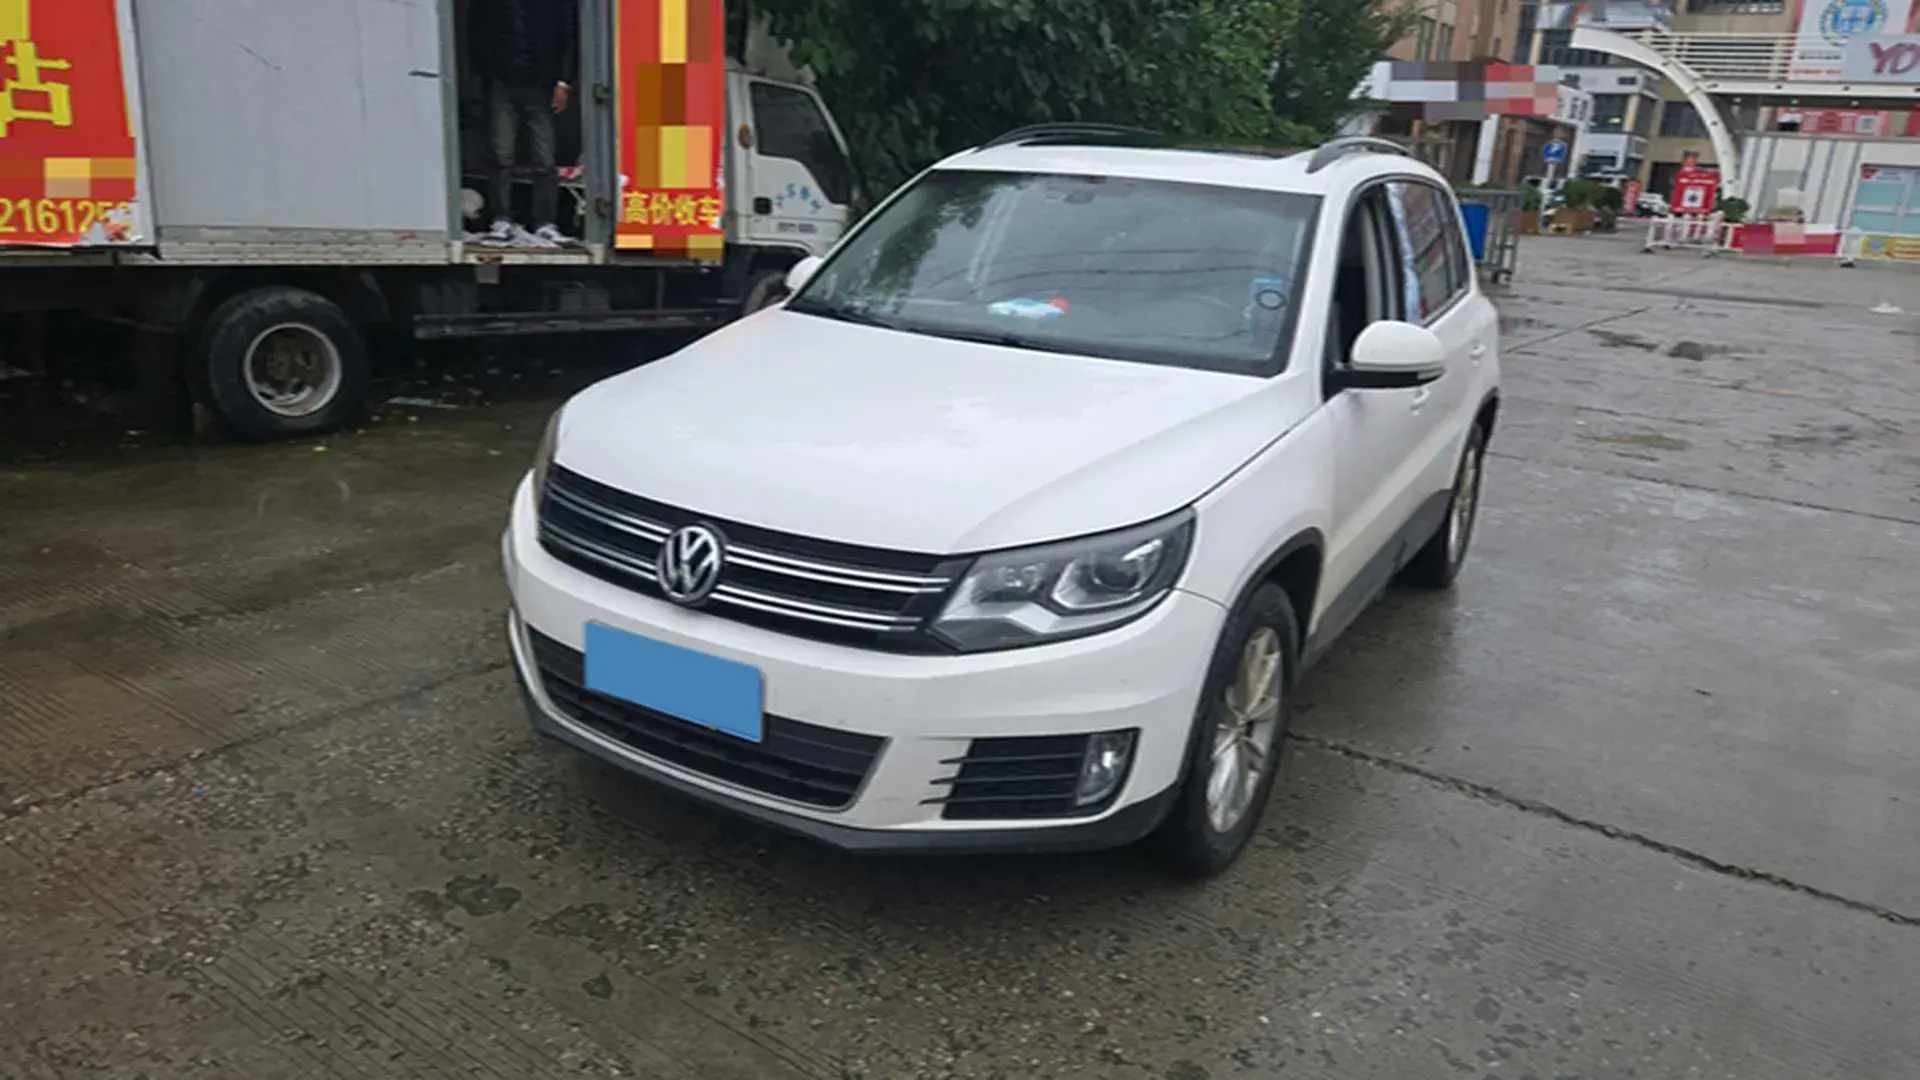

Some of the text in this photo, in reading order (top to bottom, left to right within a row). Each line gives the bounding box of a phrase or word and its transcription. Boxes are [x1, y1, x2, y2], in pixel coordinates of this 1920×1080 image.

[622, 191, 721, 226] 高价收车
[659, 525, 720, 601] VW
